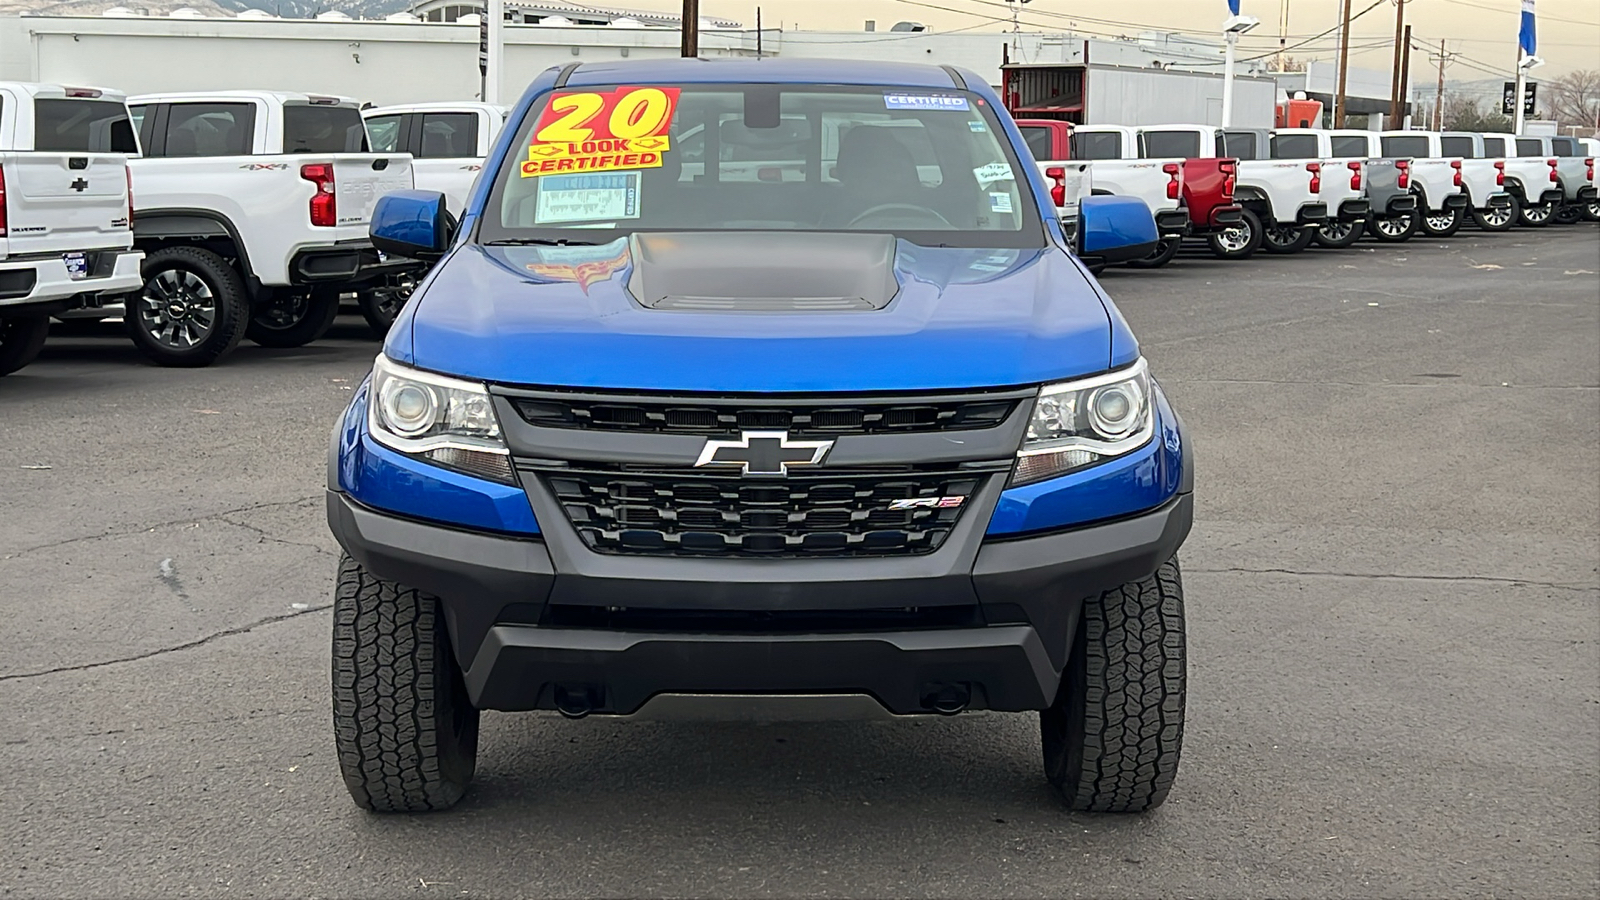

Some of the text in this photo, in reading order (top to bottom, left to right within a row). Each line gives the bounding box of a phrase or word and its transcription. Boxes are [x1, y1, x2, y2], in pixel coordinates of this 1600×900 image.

[888, 96, 964, 106] CERTIFIED
[537, 88, 671, 142] 20
[568, 139, 633, 155] LOOK
[522, 153, 659, 173] CERTIFIED
[888, 496, 964, 510] ZR2
